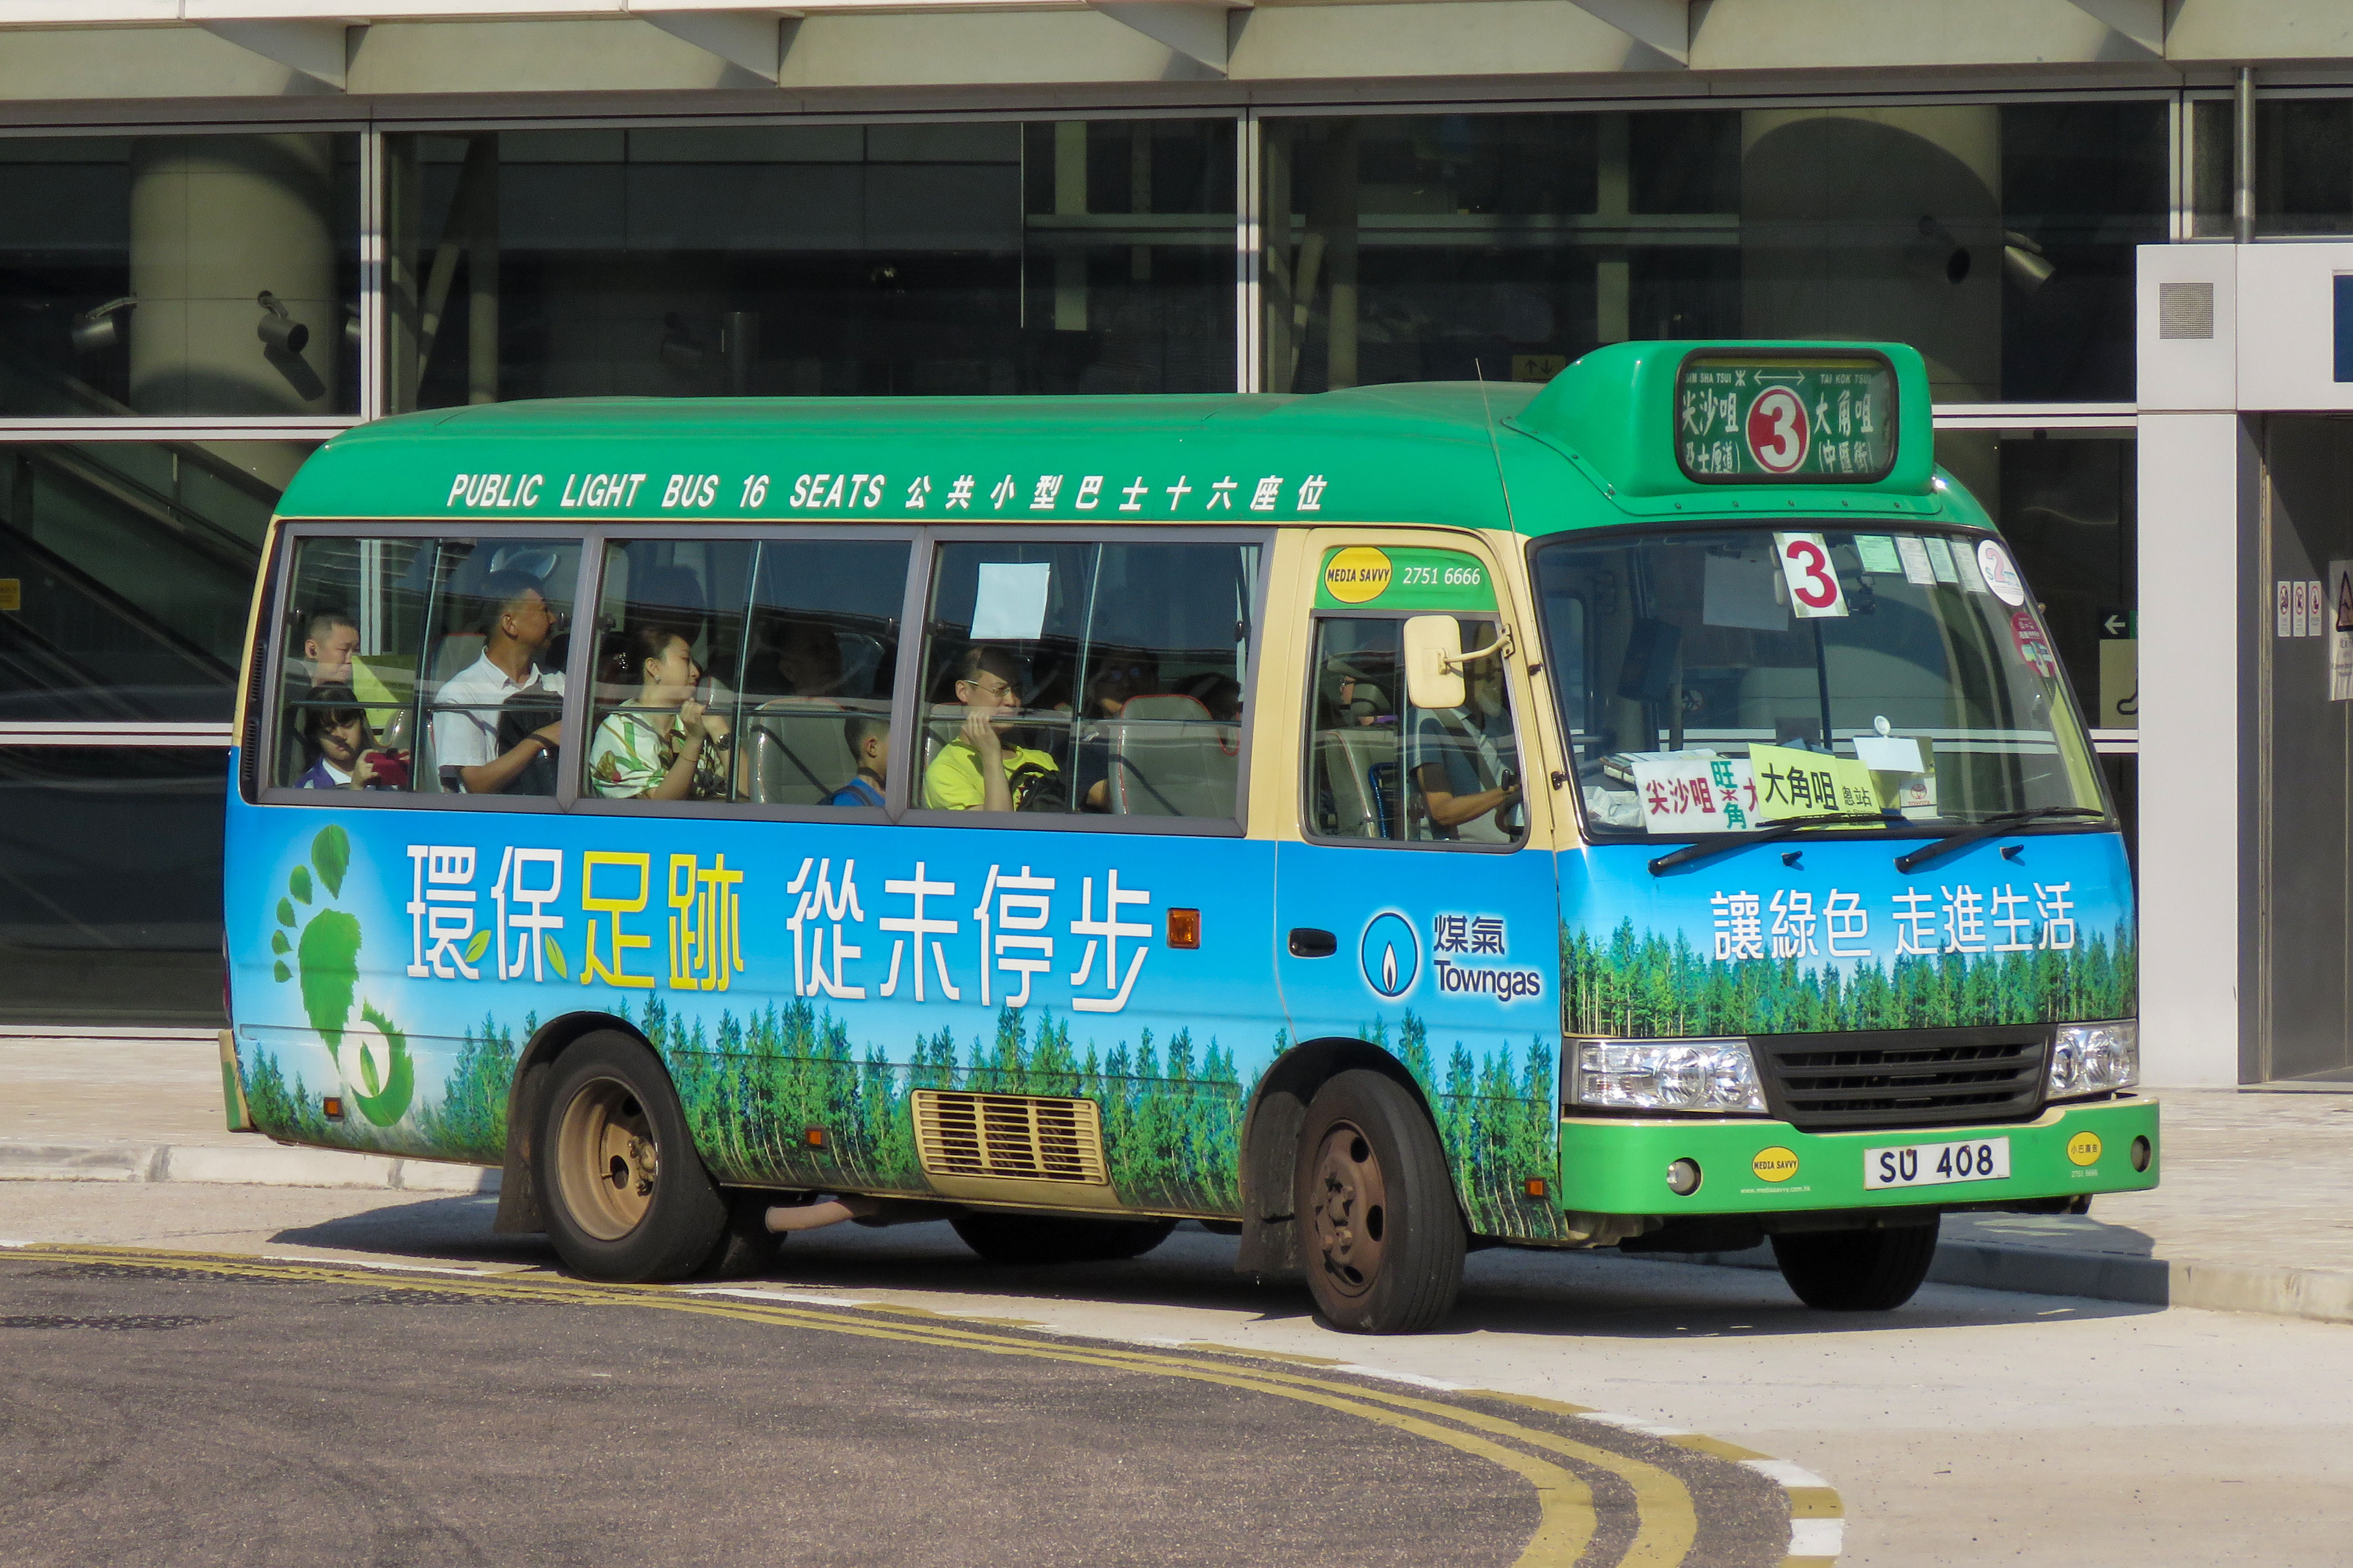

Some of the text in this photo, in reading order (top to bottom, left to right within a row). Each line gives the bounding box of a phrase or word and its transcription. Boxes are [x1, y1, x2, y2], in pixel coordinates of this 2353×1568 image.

[1700, 372, 1714, 383] SHA
[1820, 373, 1833, 384] TAI
[1835, 373, 1852, 384] KOK
[1682, 388, 1739, 437] 尖沙咀
[1759, 393, 1800, 468] 3
[1813, 389, 1874, 437] 大角咀
[446, 473, 886, 508] PUBLIC LIGHT BUS 16 SEATS
[904, 474, 1328, 511] 公共小型巴士十六座位
[1326, 568, 1390, 583] MEDIA SAVVY
[1402, 567, 1481, 585] 2751 6666
[1786, 539, 1838, 608] 3
[1646, 777, 1717, 815] 尖沙咀
[1761, 762, 1840, 811] 大角咀
[405, 844, 1153, 1013] 環保足跡 從未停步
[1433, 914, 1506, 955] 煤氣
[1710, 881, 2075, 960] 讓綠色 走進生活
[1433, 959, 1541, 1002] Towngas
[1754, 1160, 1798, 1170] MEDIA SAVVY
[1879, 1144, 1993, 1183] SU 408
